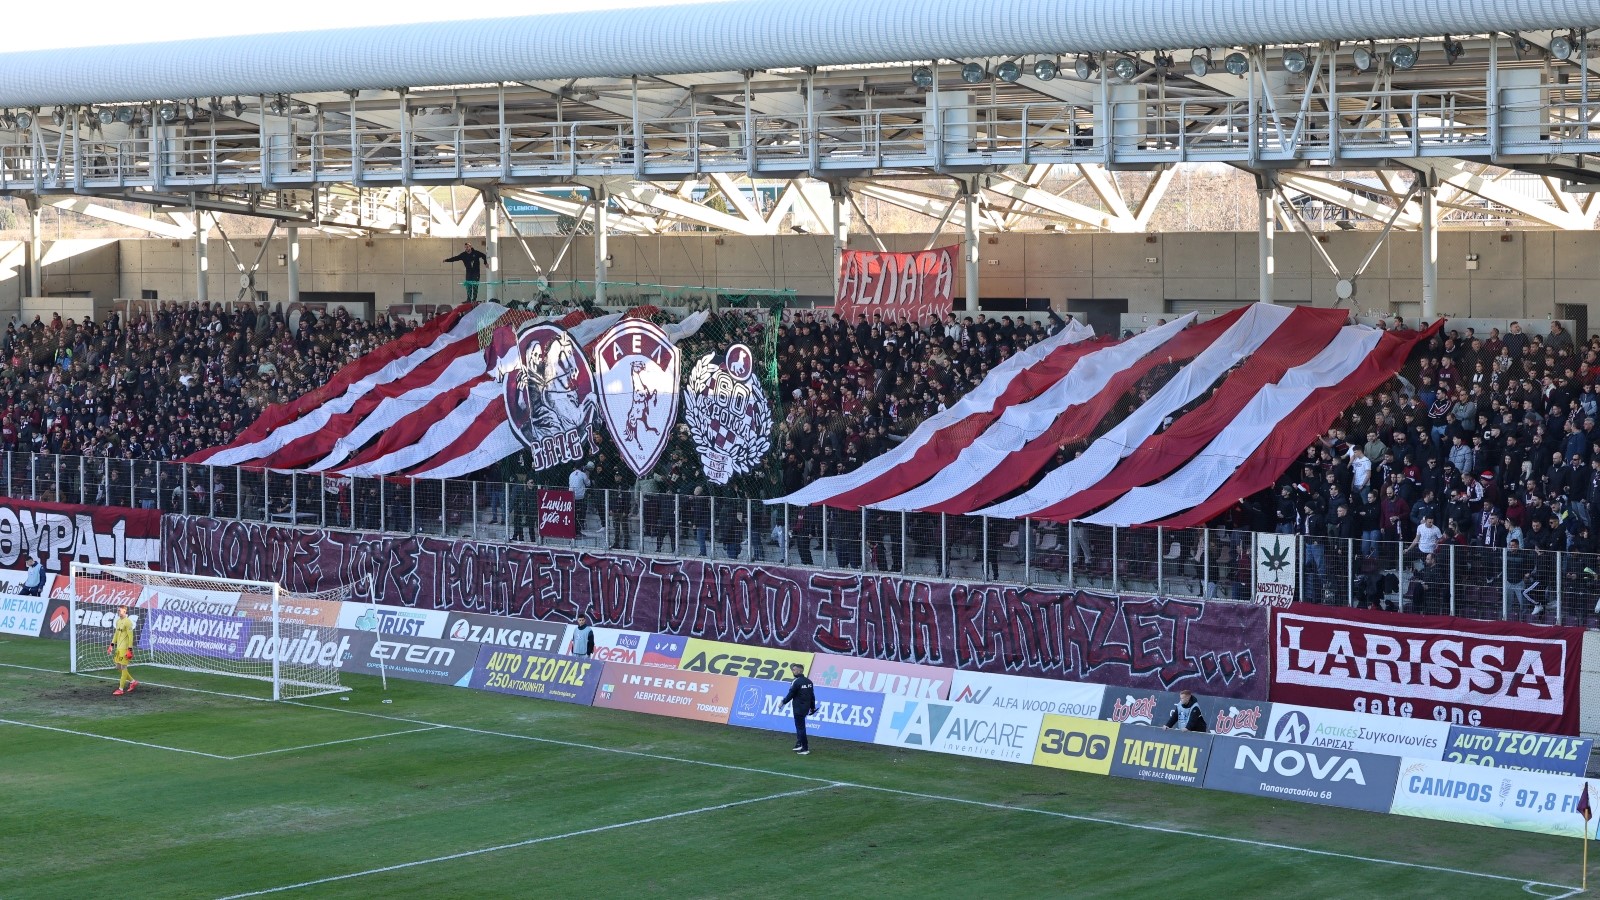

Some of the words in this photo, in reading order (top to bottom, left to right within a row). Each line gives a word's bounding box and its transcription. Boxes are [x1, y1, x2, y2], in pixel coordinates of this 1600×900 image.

[612, 334, 663, 365] ΑΕΛ
[327, 530, 421, 607] ΤΟΥΣ
[579, 552, 647, 628] ΠΟΥ
[650, 558, 690, 635] ΤΟ
[691, 561, 802, 644] ΑΛΟΓΟ
[809, 572, 944, 665] ΞΑΝΑ
[75, 608, 139, 629] CIRCS
[152, 615, 243, 640] ΑΒΡΑΜΟΥΛΗΣ
[377, 610, 425, 636] TRUST
[244, 629, 350, 667] novibet
[471, 625, 557, 651] ZAKCRET
[370, 641, 456, 666] ETEM
[1284, 625, 1552, 699] LARISSA
[486, 672, 510, 688] 250
[523, 656, 591, 686] ΤΣΟΓΙΑΣ
[622, 674, 710, 693] INTERGAS
[838, 668, 945, 699] RUBIK
[634, 691, 666, 702] ΛΕΒΗΤΑΣ
[666, 695, 693, 705] ΑΕΡΙΟΥ
[761, 694, 875, 727] MAAKAS
[992, 697, 1018, 709] ALFA
[1022, 699, 1056, 712] WOOD
[1058, 703, 1097, 716] GROUP
[1353, 697, 1413, 718] gate
[1432, 705, 1482, 726] one
[946, 717, 1027, 749] AVCARE
[1312, 737, 1354, 750] ΛΑΡΙΣΑΣ
[1495, 732, 1584, 760] ΤΣΟΓΙΑΣ
[944, 742, 996, 756] inventive
[1001, 749, 1021, 759] life
[1122, 739, 1198, 773] TACTICAL
[1138, 769, 1152, 777] LONG
[1164, 773, 1196, 783] EQUIPMENT
[1234, 744, 1366, 786] NOVA
[1260, 782, 1319, 798] Παπαναστασίου
[1320, 790, 1332, 800] 68
[1408, 775, 1493, 803] CAMPOS
[1515, 789, 1557, 813] 97,8
